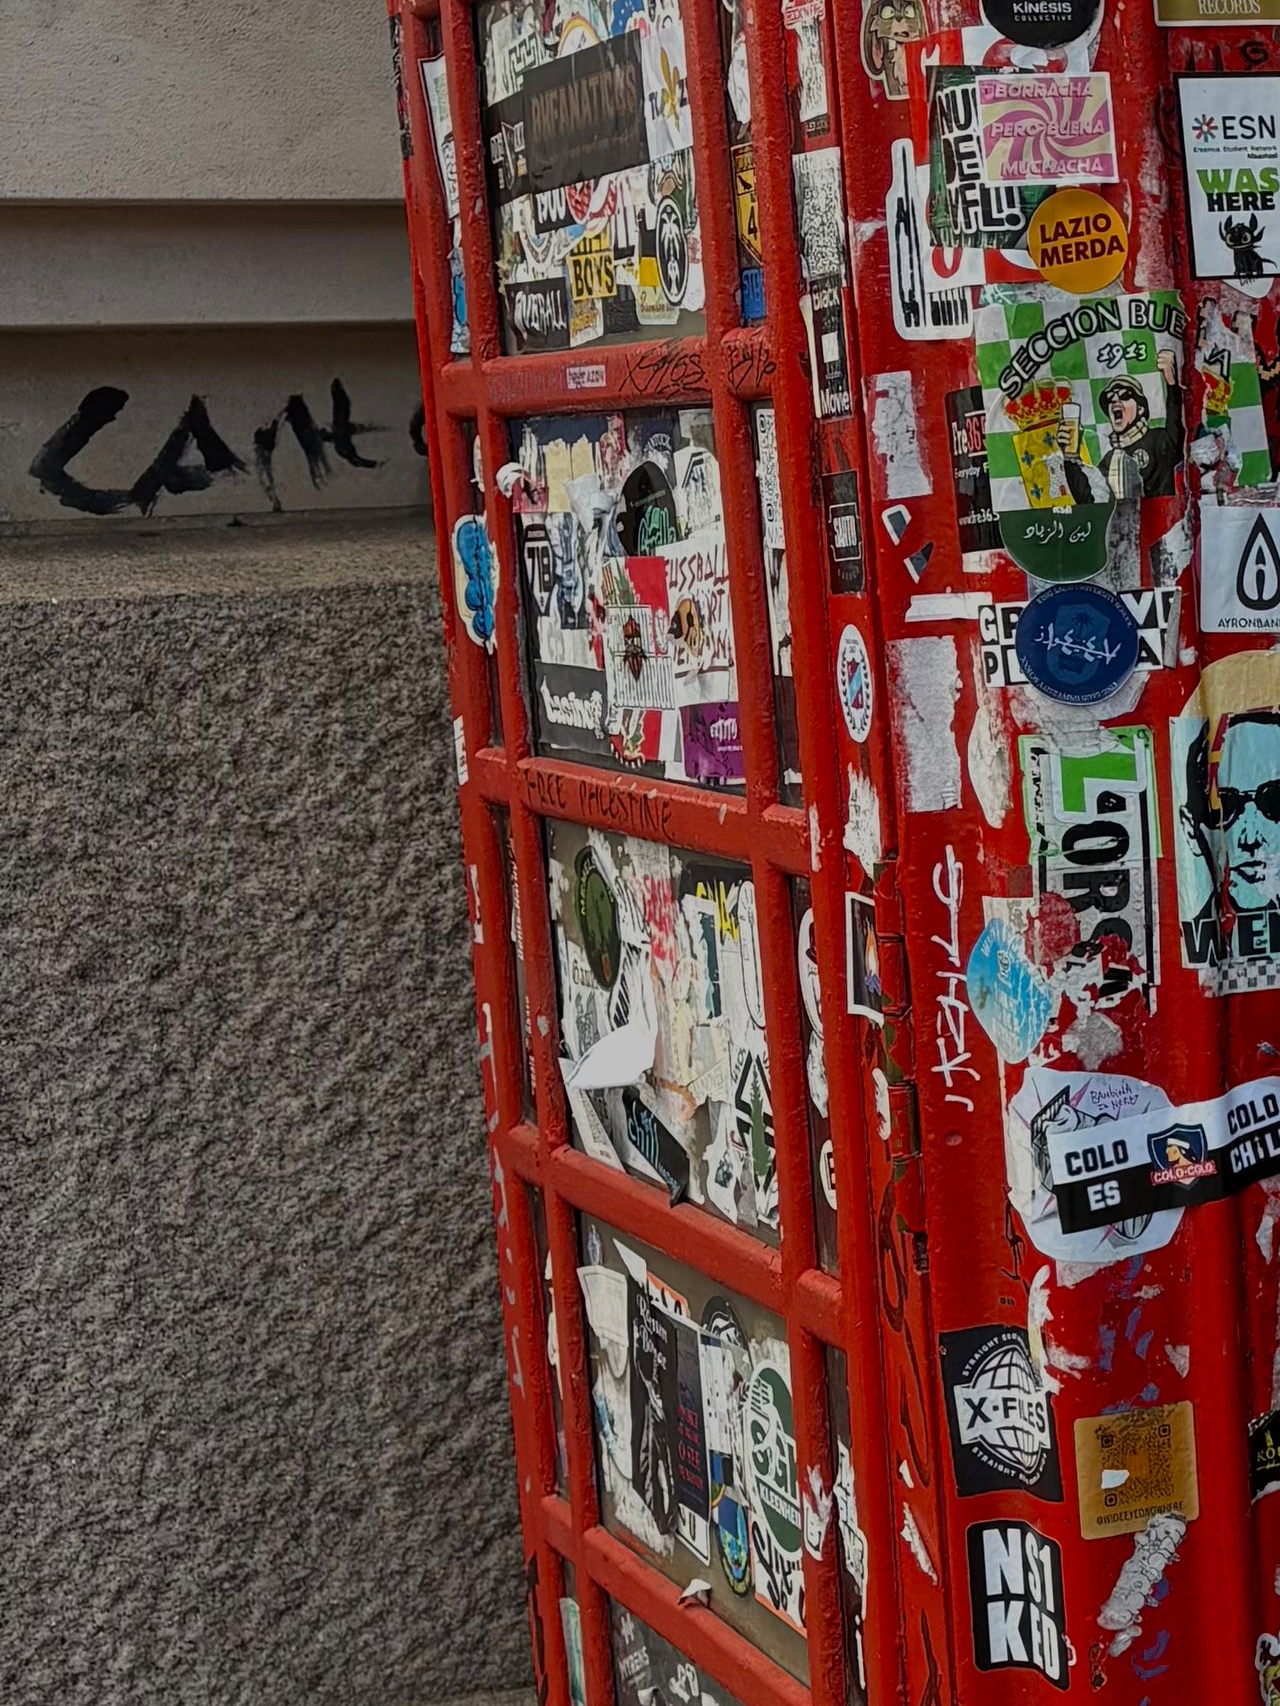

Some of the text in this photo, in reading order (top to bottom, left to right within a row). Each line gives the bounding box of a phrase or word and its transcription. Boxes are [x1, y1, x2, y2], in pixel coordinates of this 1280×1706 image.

[1222, 114, 1277, 141] ESN
[1001, 158, 1105, 176] MUCHACHA
[1206, 190, 1277, 213] HERE
[1038, 212, 1113, 244] LAZIO
[1038, 234, 1126, 268] MERDA
[997, 299, 1122, 399] SECCION
[1064, 1093, 1280, 1177] COLO COLO
[1086, 1179, 1122, 1212] ES
[963, 1395, 1047, 1431] X-FILES
